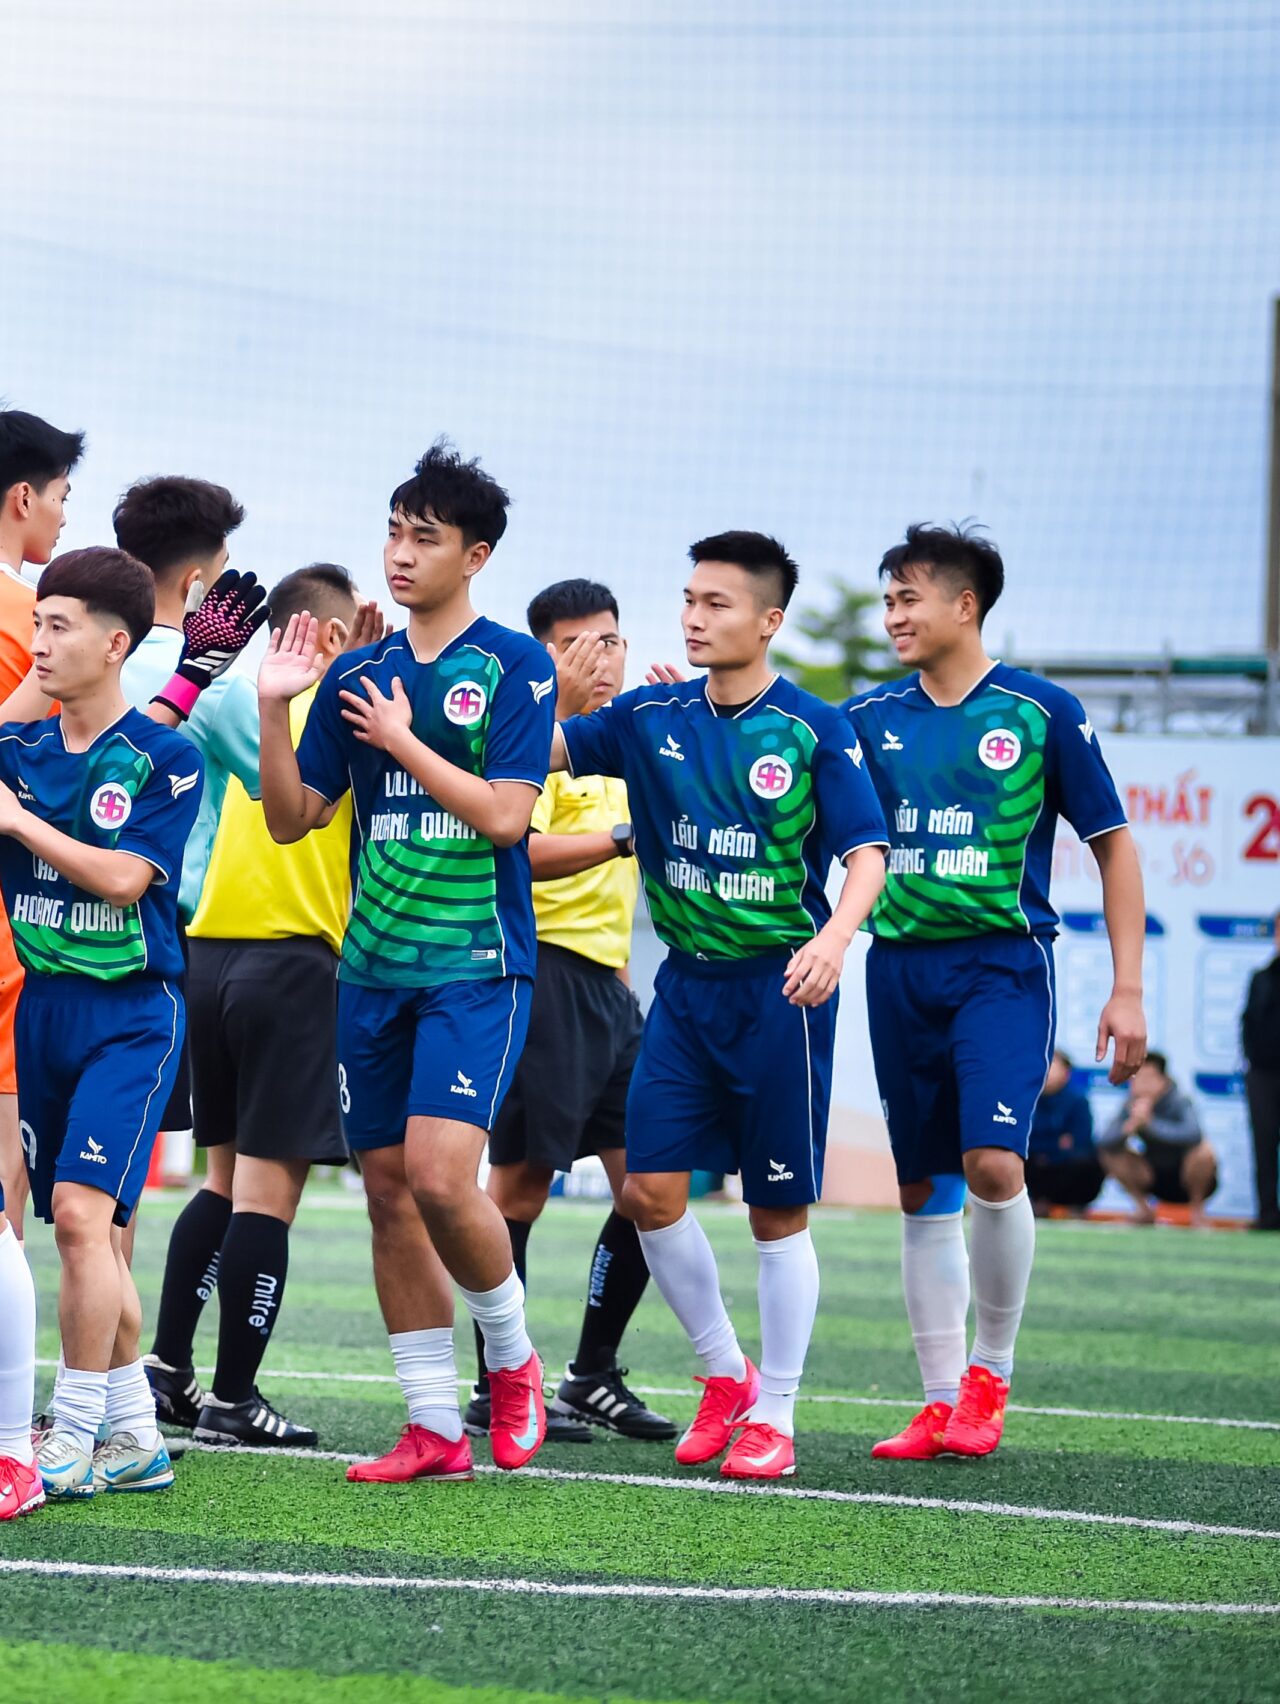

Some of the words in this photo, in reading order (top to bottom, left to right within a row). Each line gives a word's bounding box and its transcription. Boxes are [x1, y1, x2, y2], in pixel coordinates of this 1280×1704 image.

[927, 804, 974, 836] NẤM
[671, 814, 698, 851] LẨU
[707, 823, 757, 859] NẤM
[934, 845, 989, 878] QUÂN
[718, 870, 775, 902] QUÂN
[13, 890, 65, 929] HOÀNG
[450, 1084, 478, 1098] KAMITO
[79, 1151, 108, 1165] KAMITO
[767, 1171, 794, 1182] KAMITO
[248, 1273, 278, 1328] mitre
